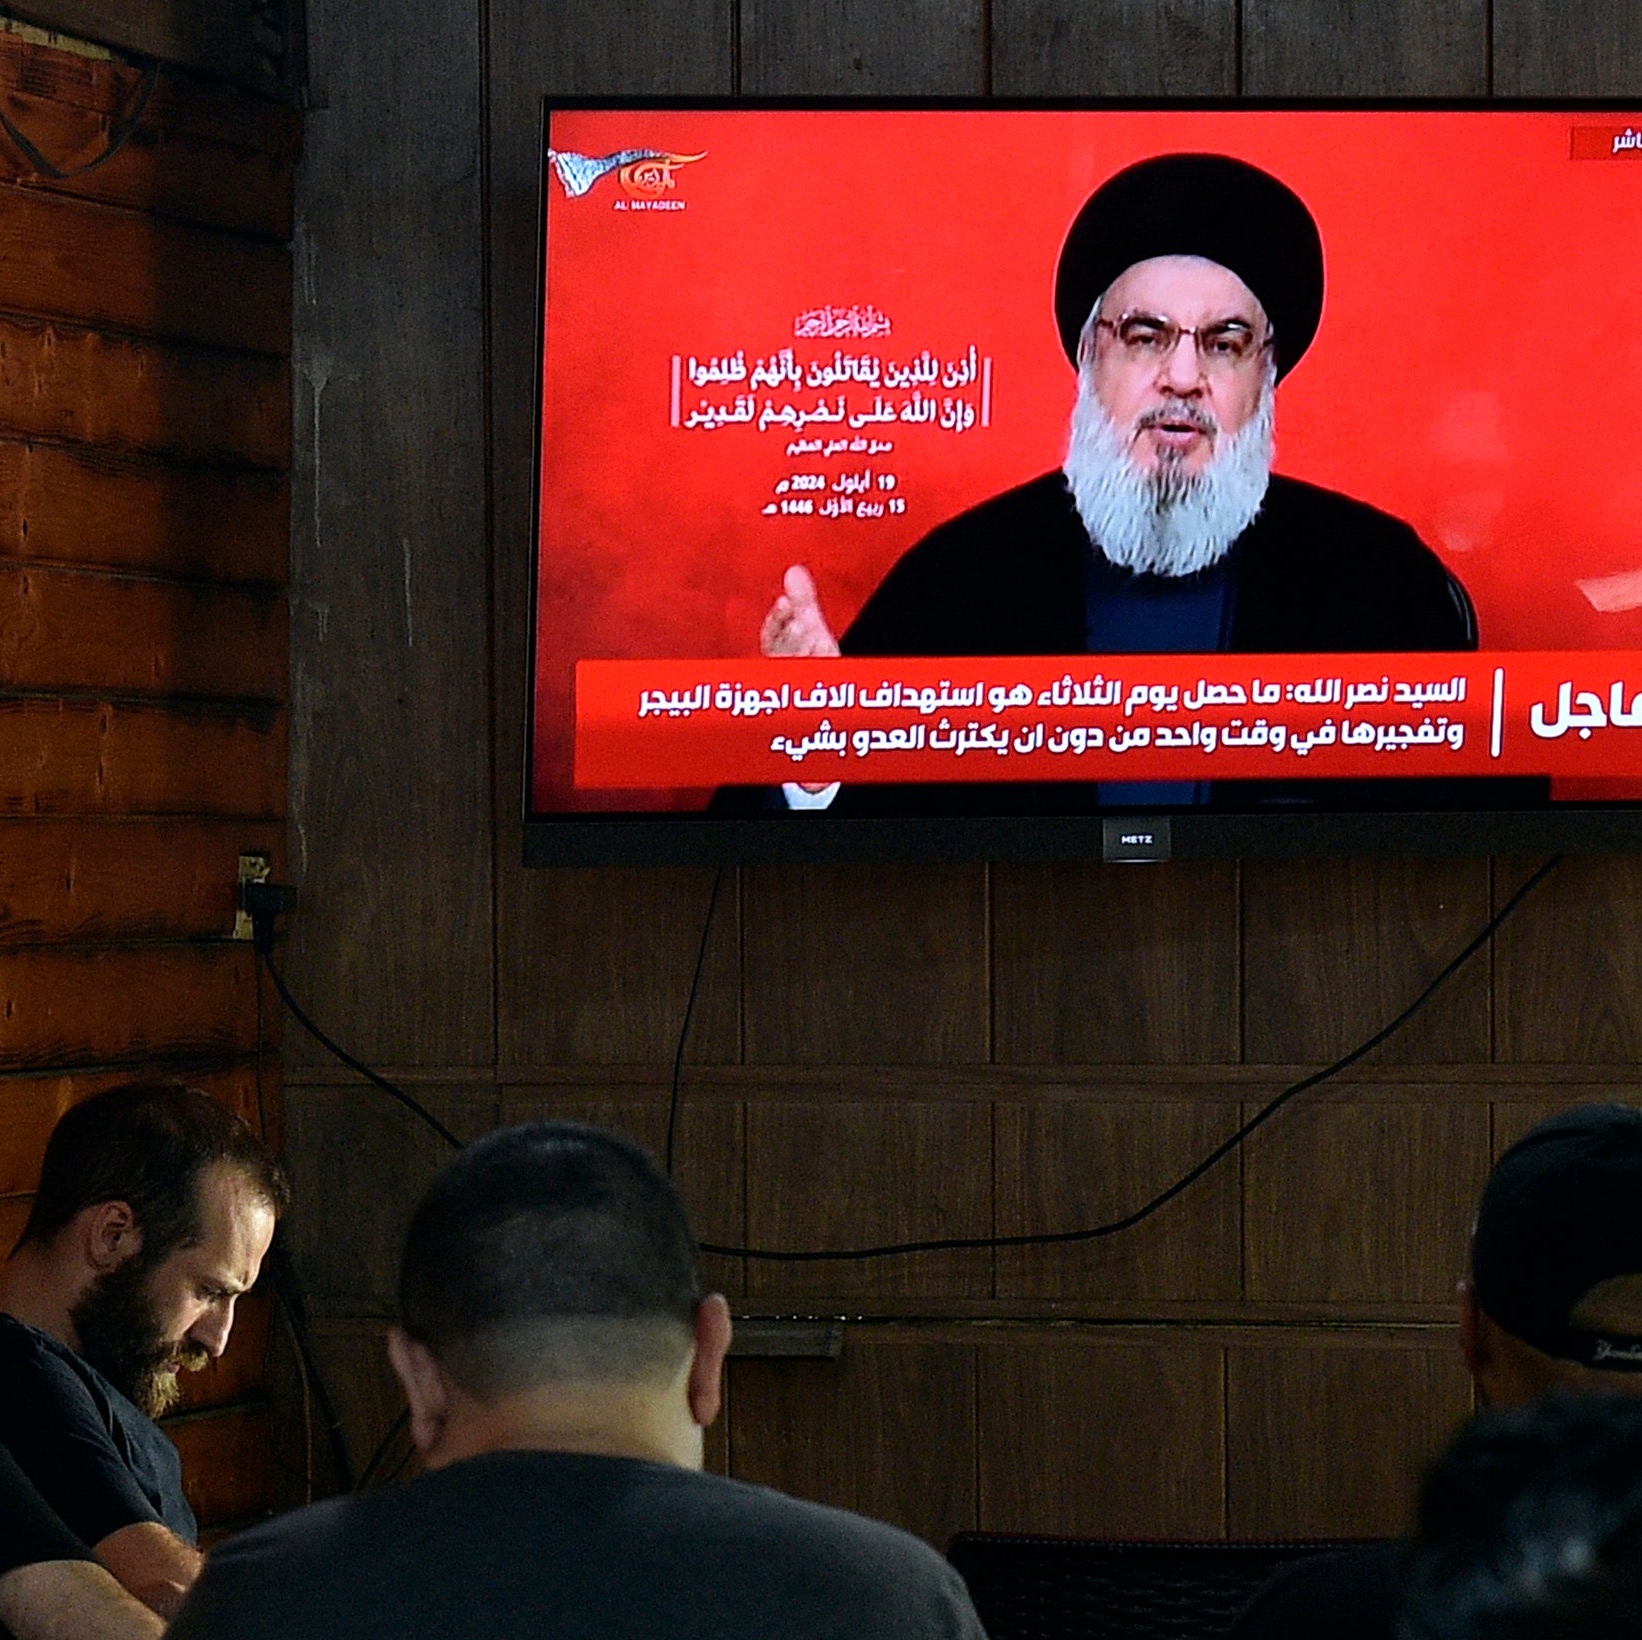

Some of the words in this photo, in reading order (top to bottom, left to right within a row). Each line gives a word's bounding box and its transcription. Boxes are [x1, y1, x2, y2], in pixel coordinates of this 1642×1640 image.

[614, 200, 628, 210] AL
[631, 200, 686, 210] MAYADEEN
[775, 480, 790, 495] م
[791, 474, 826, 490] 2024
[877, 474, 896, 490] 19
[780, 499, 814, 515] 1446
[856, 501, 884, 518] ربيع
[888, 498, 906, 514] 15
[638, 684, 711, 718] البيجر
[714, 682, 790, 717] اجهزة
[793, 681, 855, 708] الاف
[859, 680, 984, 714] استهداف
[988, 683, 1033, 714] هو
[1037, 674, 1122, 706] الثلاثاء
[1124, 685, 1179, 717] يوم
[1183, 679, 1248, 710] حصل
[1252, 679, 1281, 704] ما
[1285, 678, 1342, 703] الله:
[1343, 676, 1389, 710] نصر
[1393, 677, 1466, 709] السيد
[770, 719, 847, 762] بشيء
[852, 724, 926, 757] العدو
[929, 717, 1010, 756] يكترث
[1013, 723, 1044, 754] ان
[1047, 726, 1104, 755] دون
[1108, 725, 1151, 753] من
[1154, 721, 1217, 753] واحد
[1221, 719, 1287, 753] وقت
[1290, 718, 1337, 756] في
[1341, 717, 1464, 752] وتفجيرها
[1121, 835, 1153, 844] METZ
